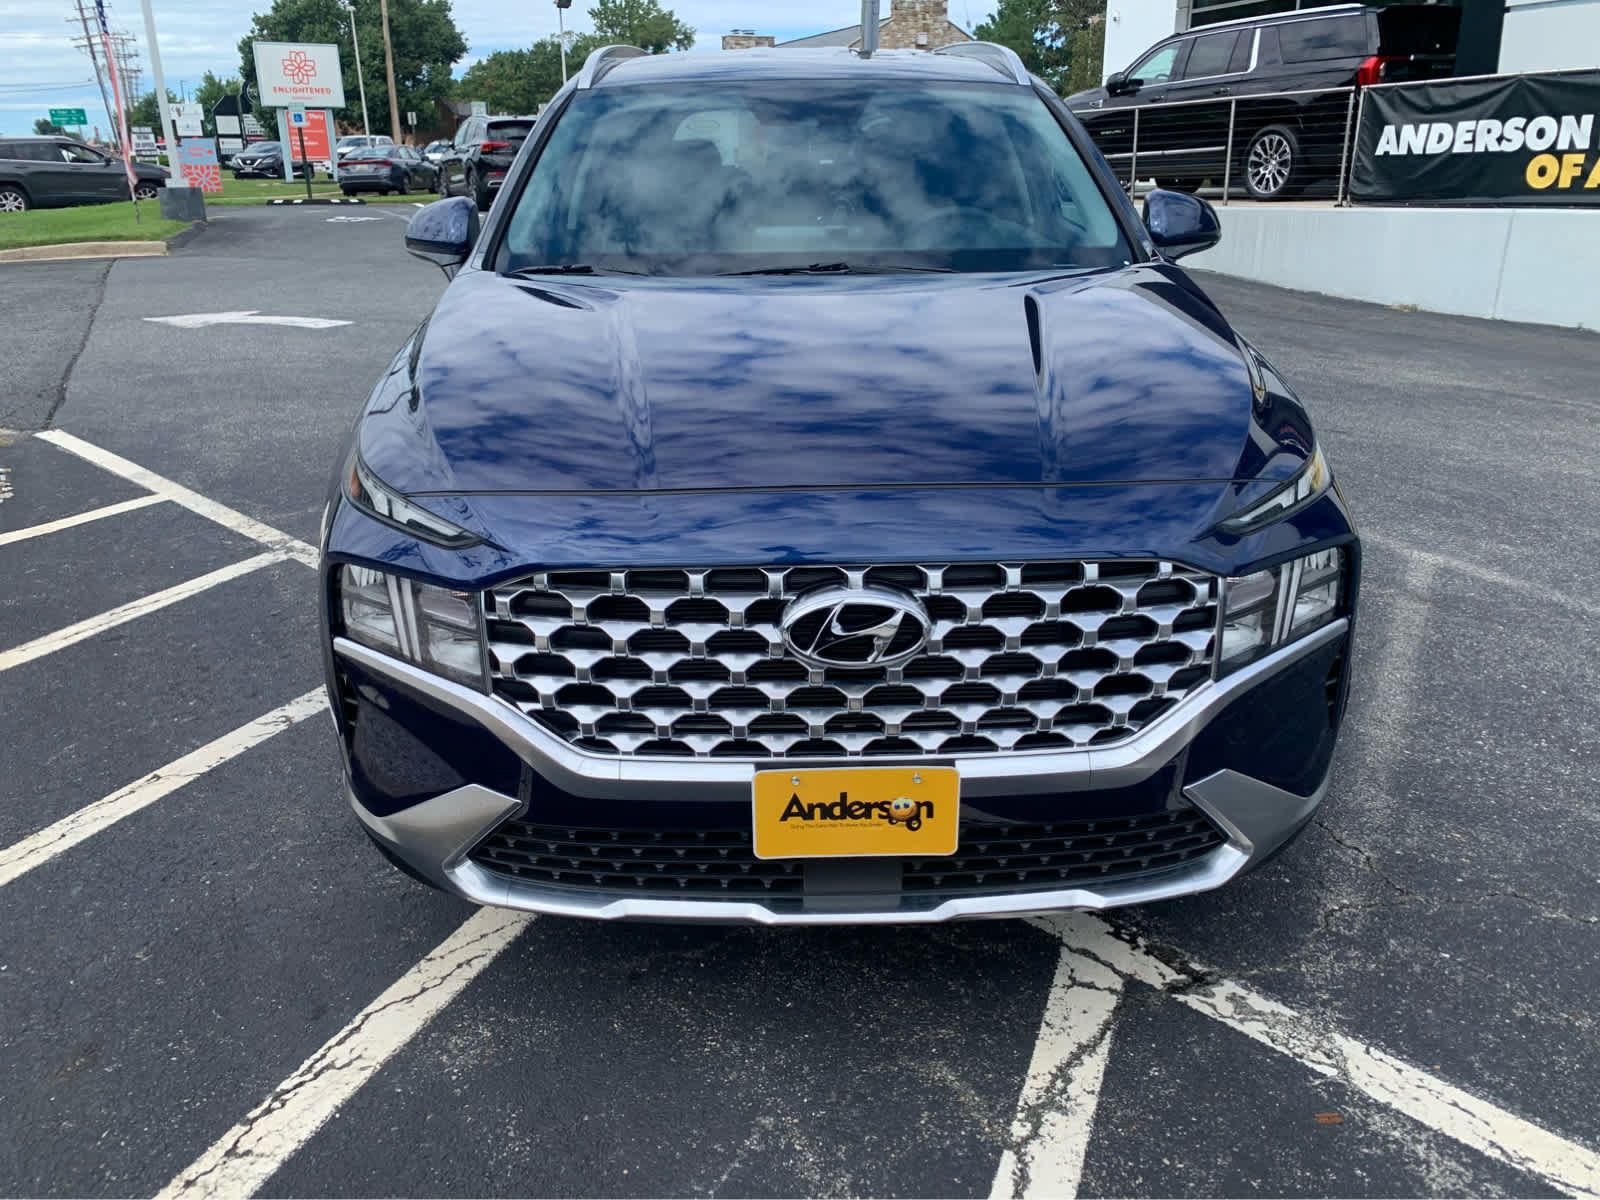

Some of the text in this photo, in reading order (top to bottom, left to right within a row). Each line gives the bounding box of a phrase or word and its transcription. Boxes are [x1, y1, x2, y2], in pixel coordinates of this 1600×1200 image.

[272, 86, 332, 95] ENLIGHTENED
[1374, 114, 1594, 156] ANDERSON
[1525, 153, 1586, 189] OF
[779, 791, 934, 824] Anderson
